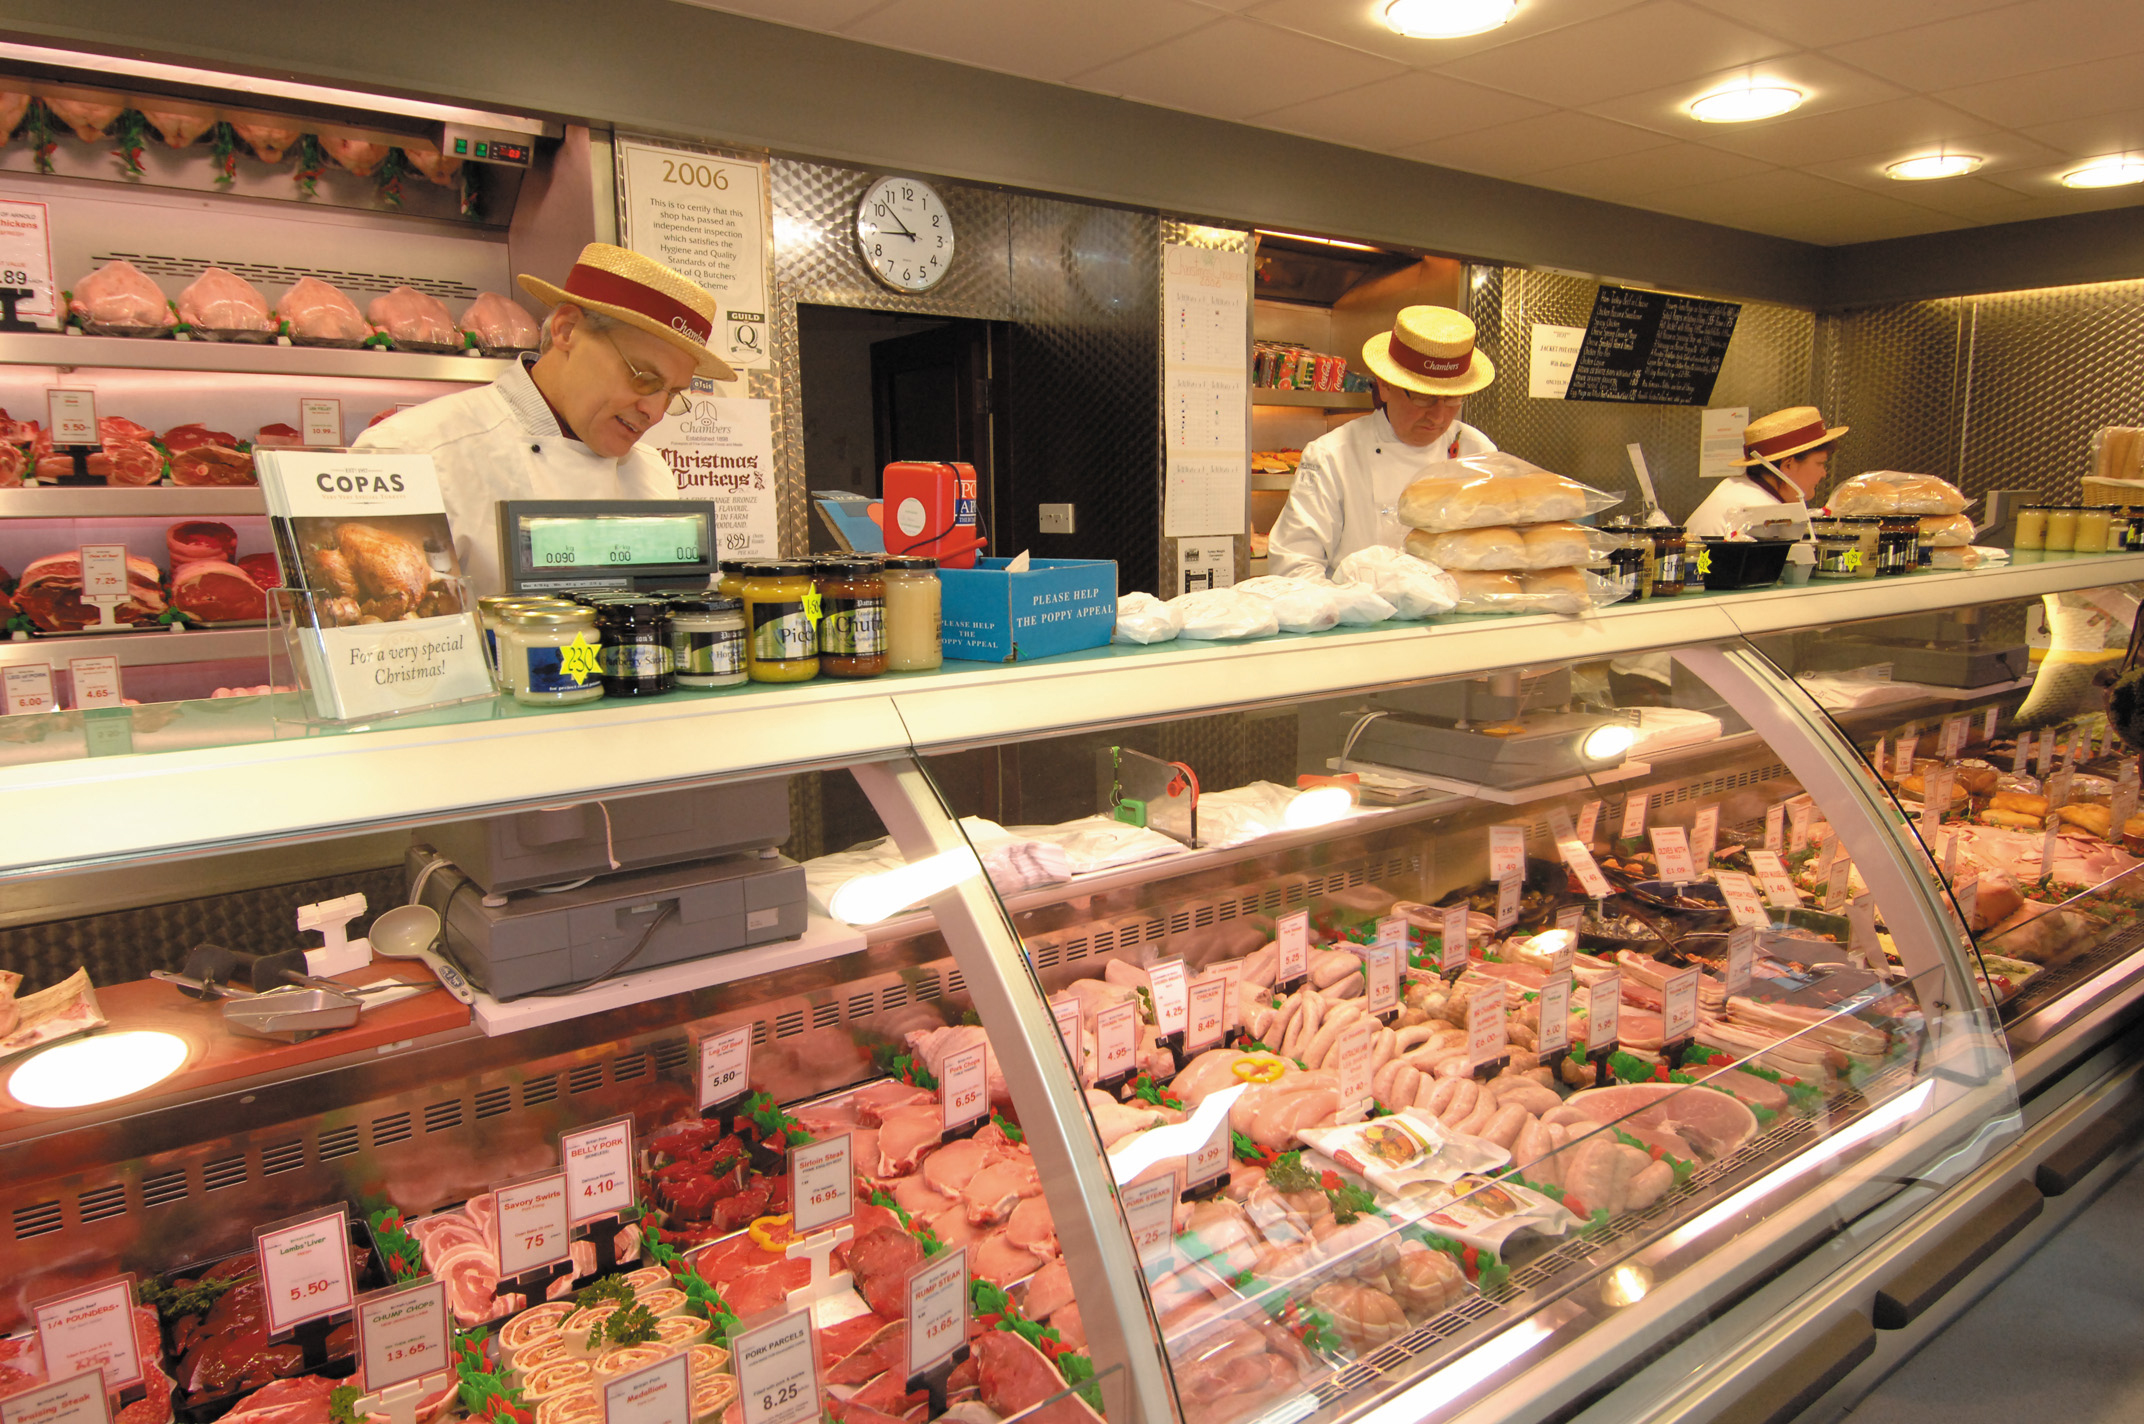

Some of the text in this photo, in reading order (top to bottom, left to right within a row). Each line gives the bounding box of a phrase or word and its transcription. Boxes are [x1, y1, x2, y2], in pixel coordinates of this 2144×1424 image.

[662, 160, 729, 190] 2006
[886, 190, 895, 204] 11
[901, 187, 914, 202] 12
[650, 198, 666, 207] This
[668, 201, 675, 209] is
[687, 205, 711, 215] certify
[713, 207, 727, 215] that
[730, 209, 743, 217] this
[874, 203, 886, 217] 10
[922, 198, 926, 211] 1
[0, 219, 38, 229] hickens
[660, 211, 679, 221] shop
[681, 213, 695, 222] has
[697, 217, 724, 226] passed
[932, 215, 940, 227] 2
[653, 221, 743, 238] independent inspection
[664, 234, 733, 248] which satisfies the
[937, 235, 943, 248] 3
[660, 244, 692, 255] Hygiene
[710, 249, 737, 261] Quality
[875, 243, 883, 257] 8
[668, 256, 706, 267] Standards
[888, 259, 895, 272] 7
[930, 255, 938, 267] 4
[694, 269, 702, 278] Q
[903, 268, 910, 280] 6
[920, 266, 927, 278] 5
[698, 280, 728, 290] Scheme
[731, 312, 760, 321] GUILD
[737, 325, 758, 349] Q
[1423, 360, 1459, 371] Chambers
[680, 422, 731, 434] Chambers
[656, 448, 758, 469] Christmas
[316, 473, 405, 493] COPAS
[672, 469, 751, 493] Turkeys
[546, 547, 699, 564] 0.090 0.00 0.00
[1032, 588, 1100, 606] PLEASE HELP
[1016, 604, 1114, 628] THE POPPY APPEAL
[836, 616, 888, 633] Chut
[959, 630, 976, 638] THE
[350, 634, 464, 666] For a very special
[966, 640, 998, 649] APPEAL
[374, 660, 446, 685] Christmas!
[86, 689, 109, 698] 4.65
[19, 697, 42, 707] 6.00
[1769, 884, 1786, 893] 1.49
[1736, 905, 1755, 914] 1.49
[1165, 1006, 1183, 1018] 4.25
[1197, 1018, 1215, 1032] 8.49
[708, 1048, 721, 1056] Leg
[729, 1039, 744, 1049] Beef
[1107, 1047, 1127, 1061] 4.95
[949, 1065, 962, 1073] Pork
[963, 1058, 980, 1068] Chops
[713, 1071, 735, 1087] 5.80
[955, 1091, 976, 1108] 6.55
[571, 1137, 624, 1158] BELLY PORK
[799, 1150, 844, 1169] Sirloin Steak
[1197, 1148, 1219, 1164] 9.99
[584, 1179, 614, 1197] 4.10
[504, 1198, 534, 1211] Savory
[810, 1189, 837, 1205] 16.95
[1126, 1197, 1144, 1208] PORK
[1146, 1188, 1170, 1202] STEAKS
[525, 1233, 545, 1250] 75
[290, 1279, 328, 1301] 5.50
[915, 1283, 937, 1300] RUMP
[938, 1269, 961, 1288] STEAK
[372, 1300, 435, 1323] CHUMP CHOPS
[48, 1320, 63, 1329] 1/4
[926, 1316, 953, 1339] 13.65
[387, 1342, 426, 1362] 13.65
[745, 1346, 767, 1360] PORK
[768, 1329, 804, 1350] PARCELS
[627, 1382, 668, 1403] Medallions
[763, 1383, 798, 1410] 8.25
[17, 1393, 90, 1424] Braising Steak
